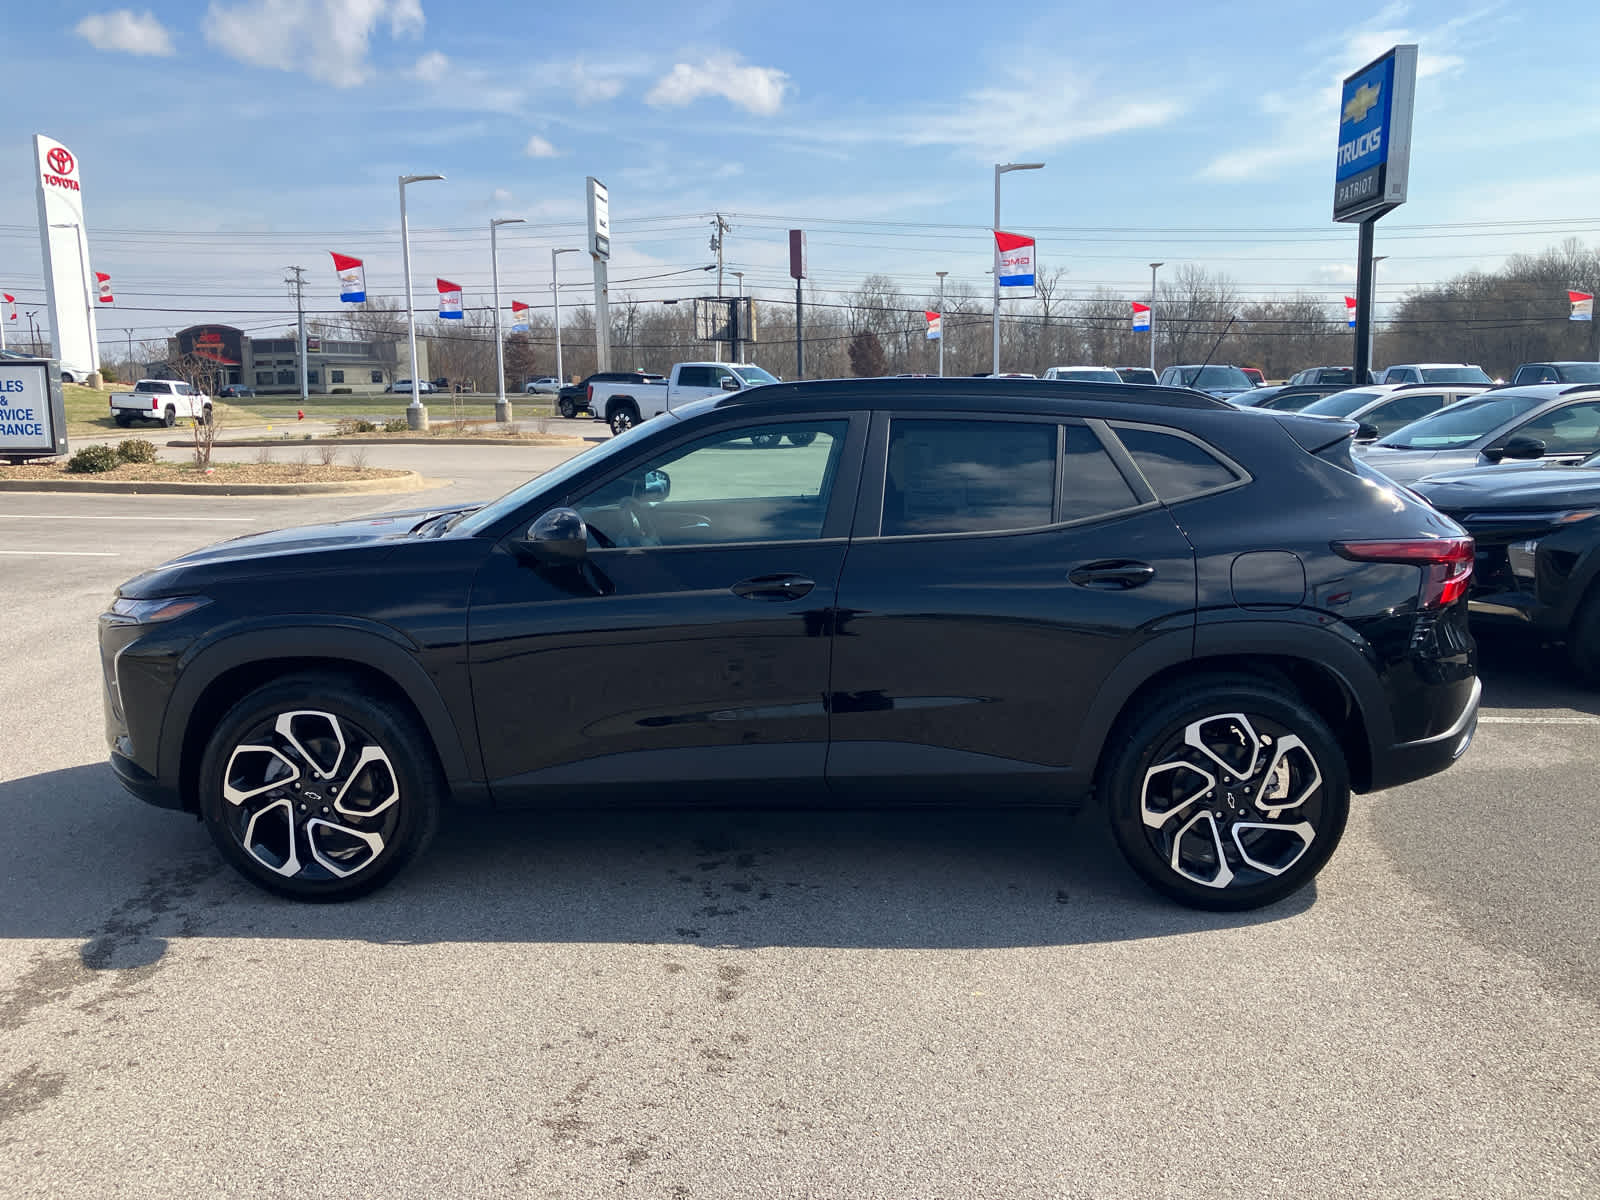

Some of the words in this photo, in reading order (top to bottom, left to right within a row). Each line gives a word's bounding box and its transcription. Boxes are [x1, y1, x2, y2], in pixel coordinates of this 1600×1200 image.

[1338, 126, 1381, 167] TRUCKS
[43, 173, 80, 191] TOYOTA
[1339, 175, 1373, 201] PATRIOT
